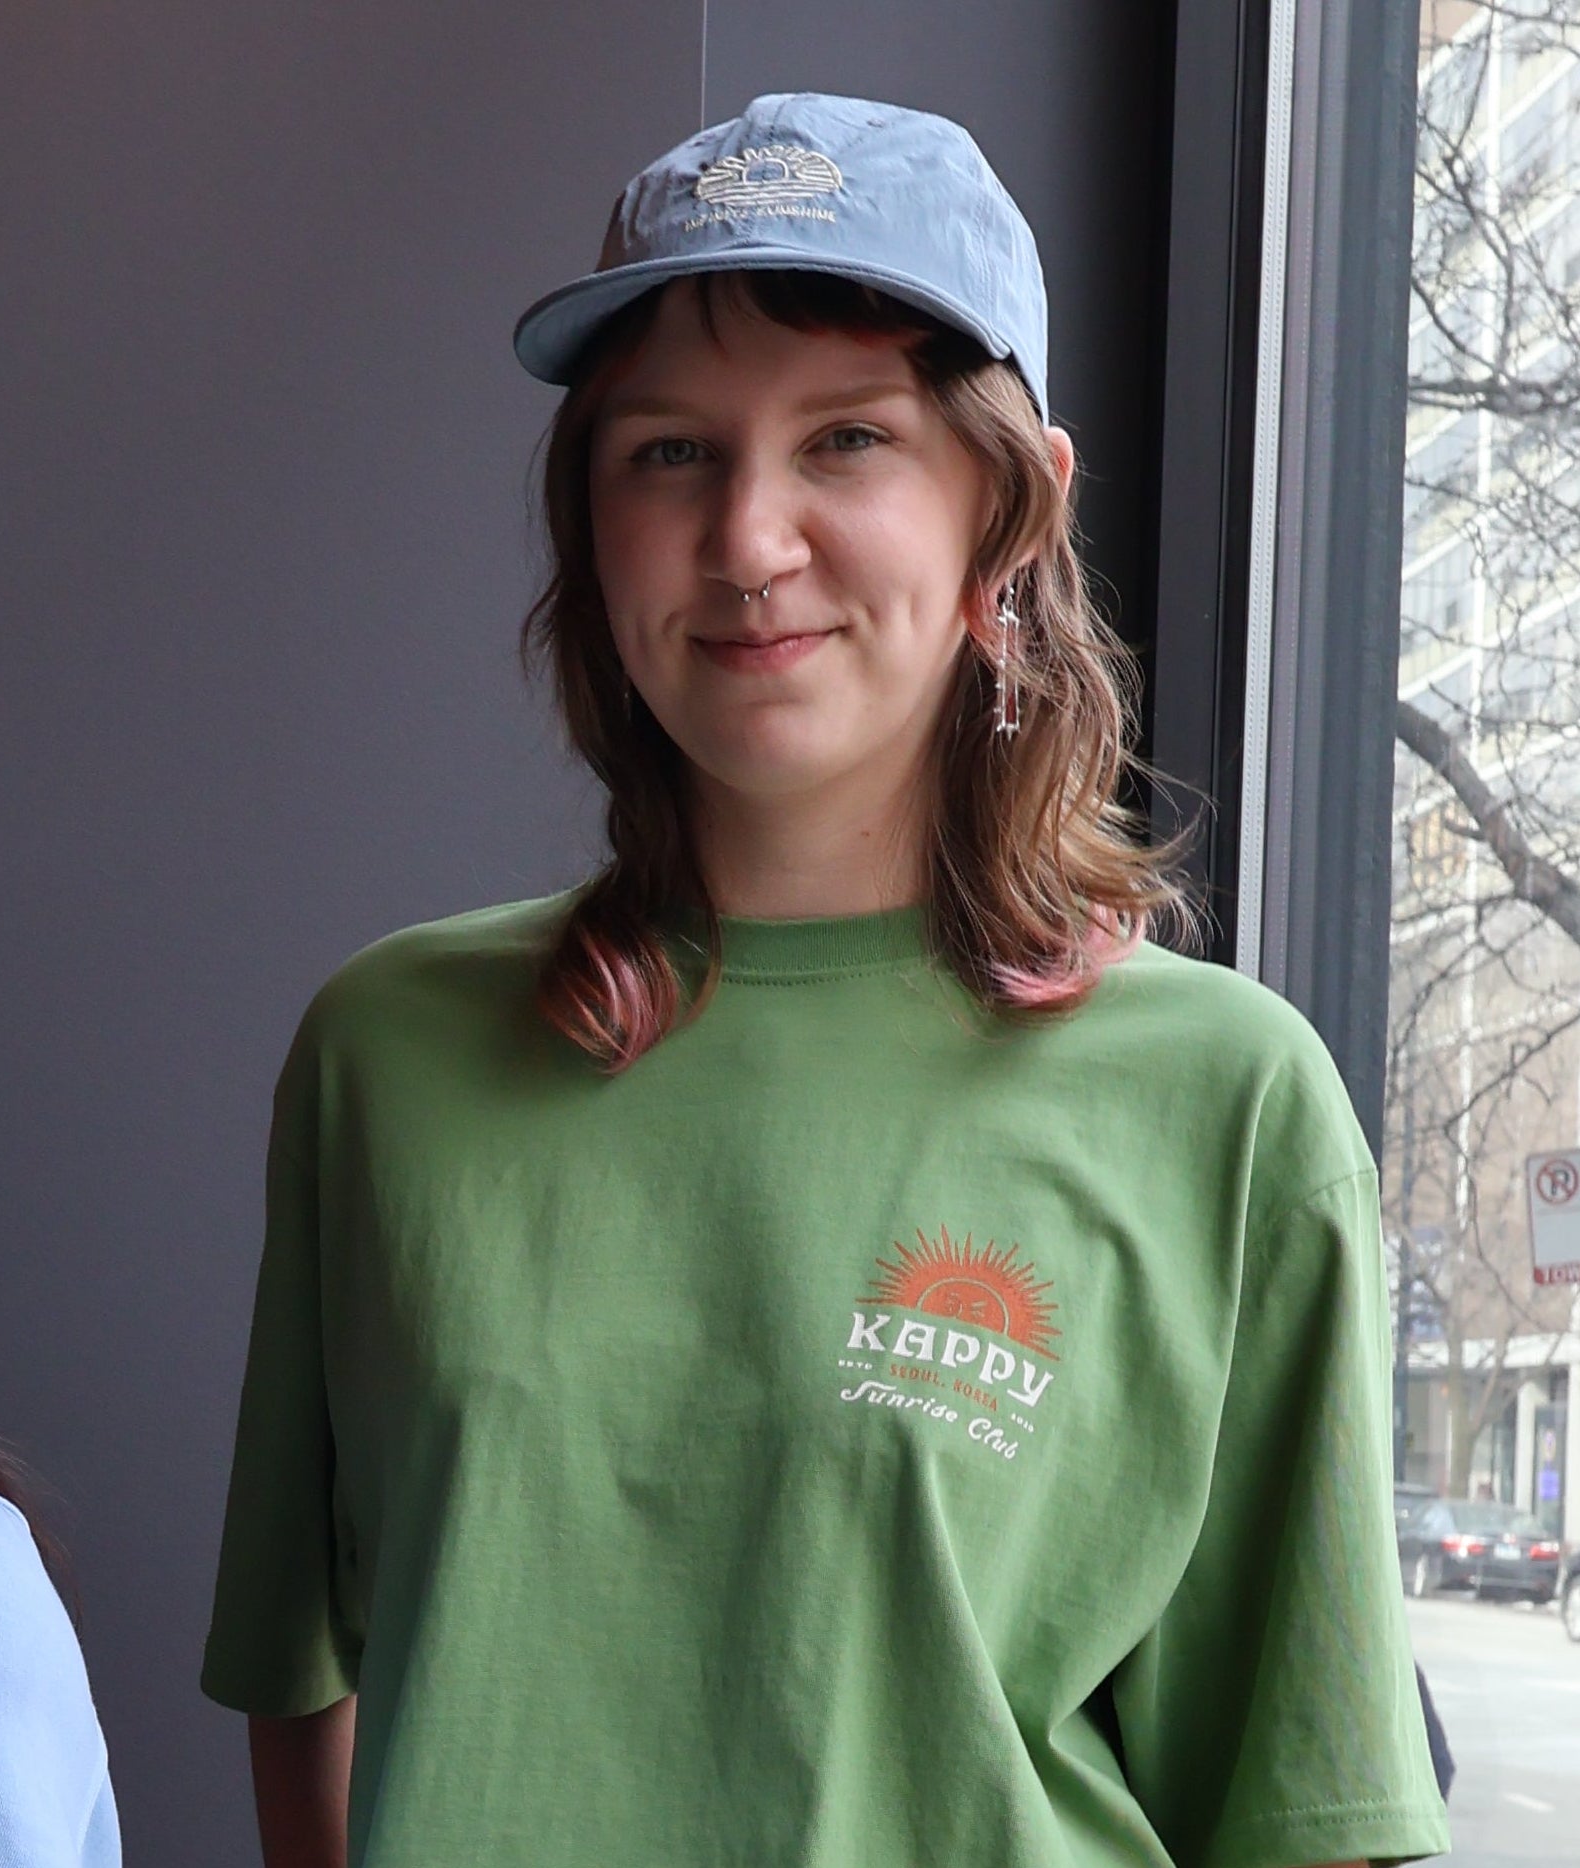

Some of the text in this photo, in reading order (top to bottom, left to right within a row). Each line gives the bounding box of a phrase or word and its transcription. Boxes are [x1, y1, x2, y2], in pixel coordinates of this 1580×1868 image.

[846, 1312, 1055, 1407] KAPPY
[840, 1379, 1019, 1460] Sunrise Club
